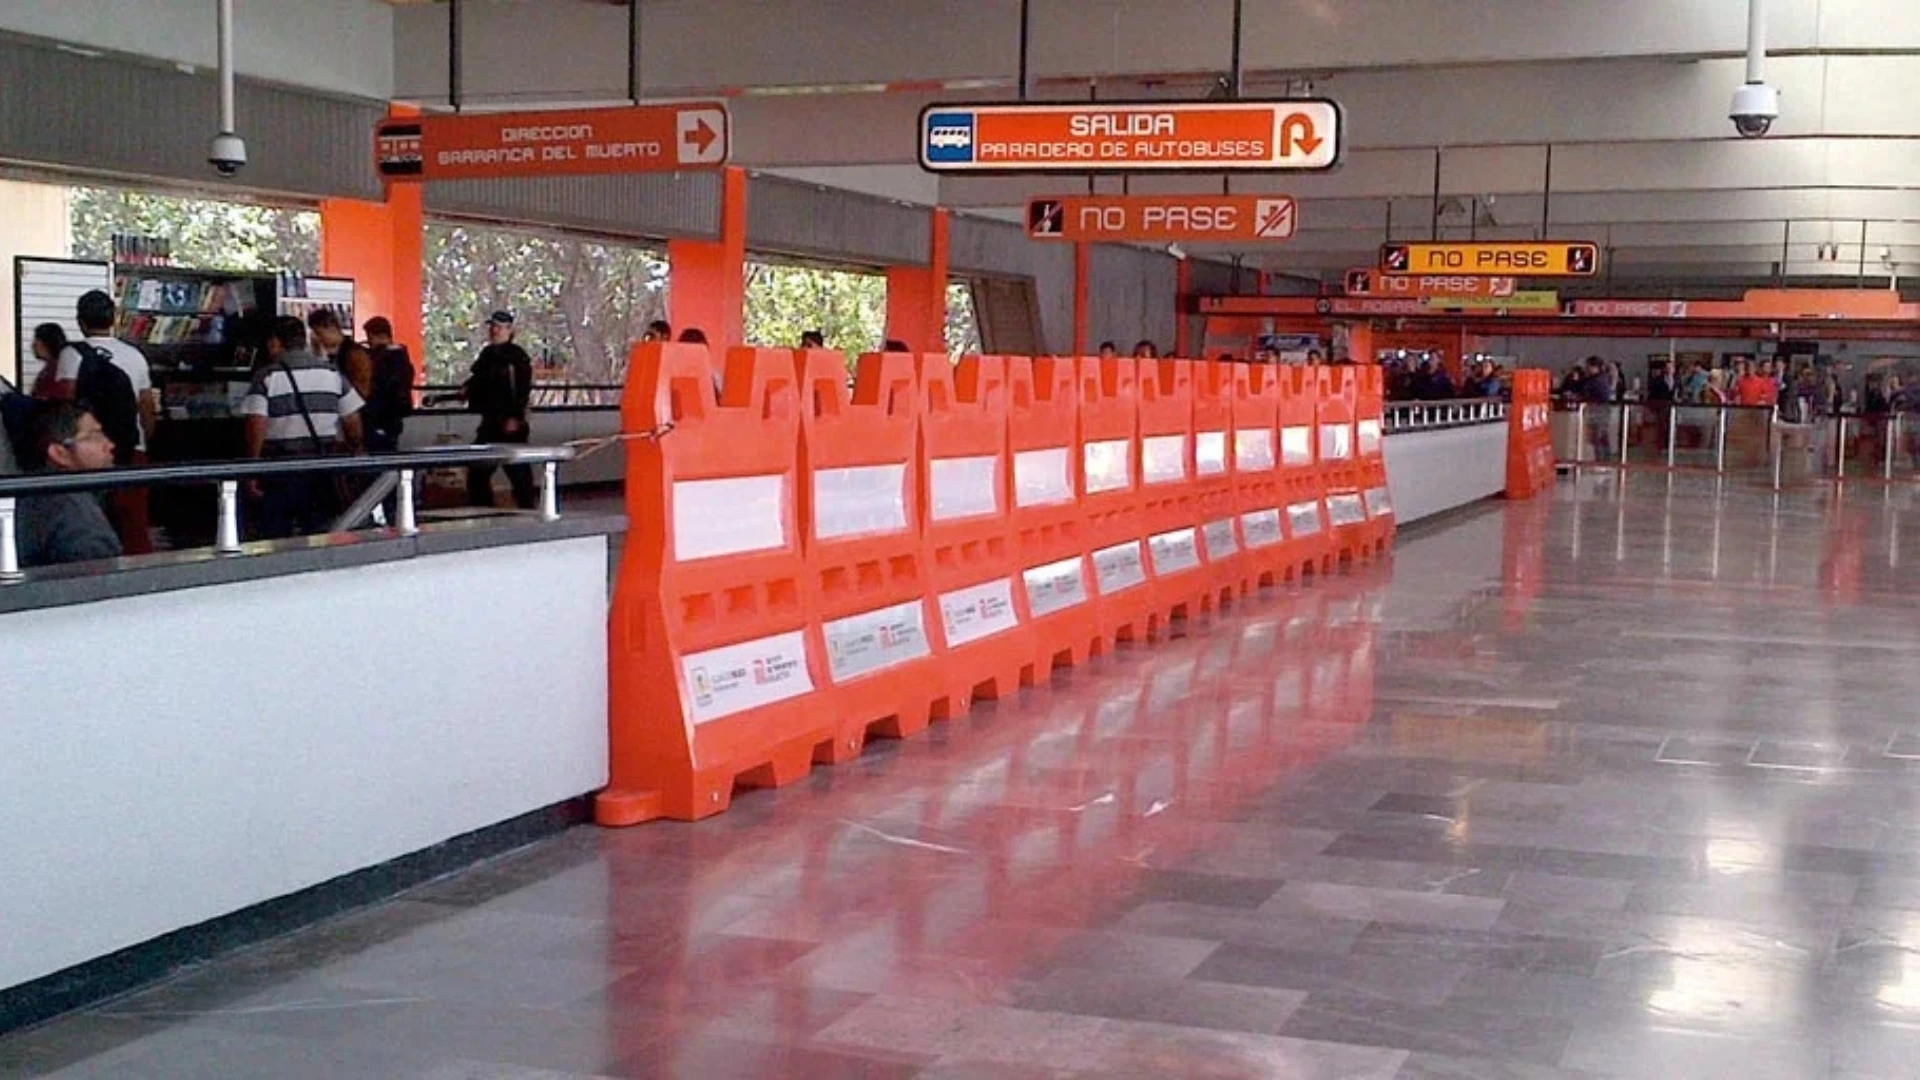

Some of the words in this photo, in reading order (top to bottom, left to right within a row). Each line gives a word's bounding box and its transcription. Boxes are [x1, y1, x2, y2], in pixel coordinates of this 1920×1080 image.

[502, 124, 592, 142] DIRECCION
[1070, 113, 1175, 137] SALIDA
[438, 147, 535, 165] BARRANCA
[542, 145, 576, 161] DEL
[586, 142, 661, 159] MUERTO
[980, 142, 1094, 158] PARADERO
[1100, 142, 1127, 158] DE
[1134, 140, 1265, 157] AUTOBUSES
[1079, 206, 1126, 231] NO
[1143, 205, 1238, 231] PASE
[1428, 250, 1463, 267] NO
[1476, 250, 1548, 267] PASE
[1379, 275, 1409, 292] NO
[1419, 275, 1480, 292] PASE
[1584, 302, 1606, 315] NO
[1615, 302, 1659, 316] PASE
